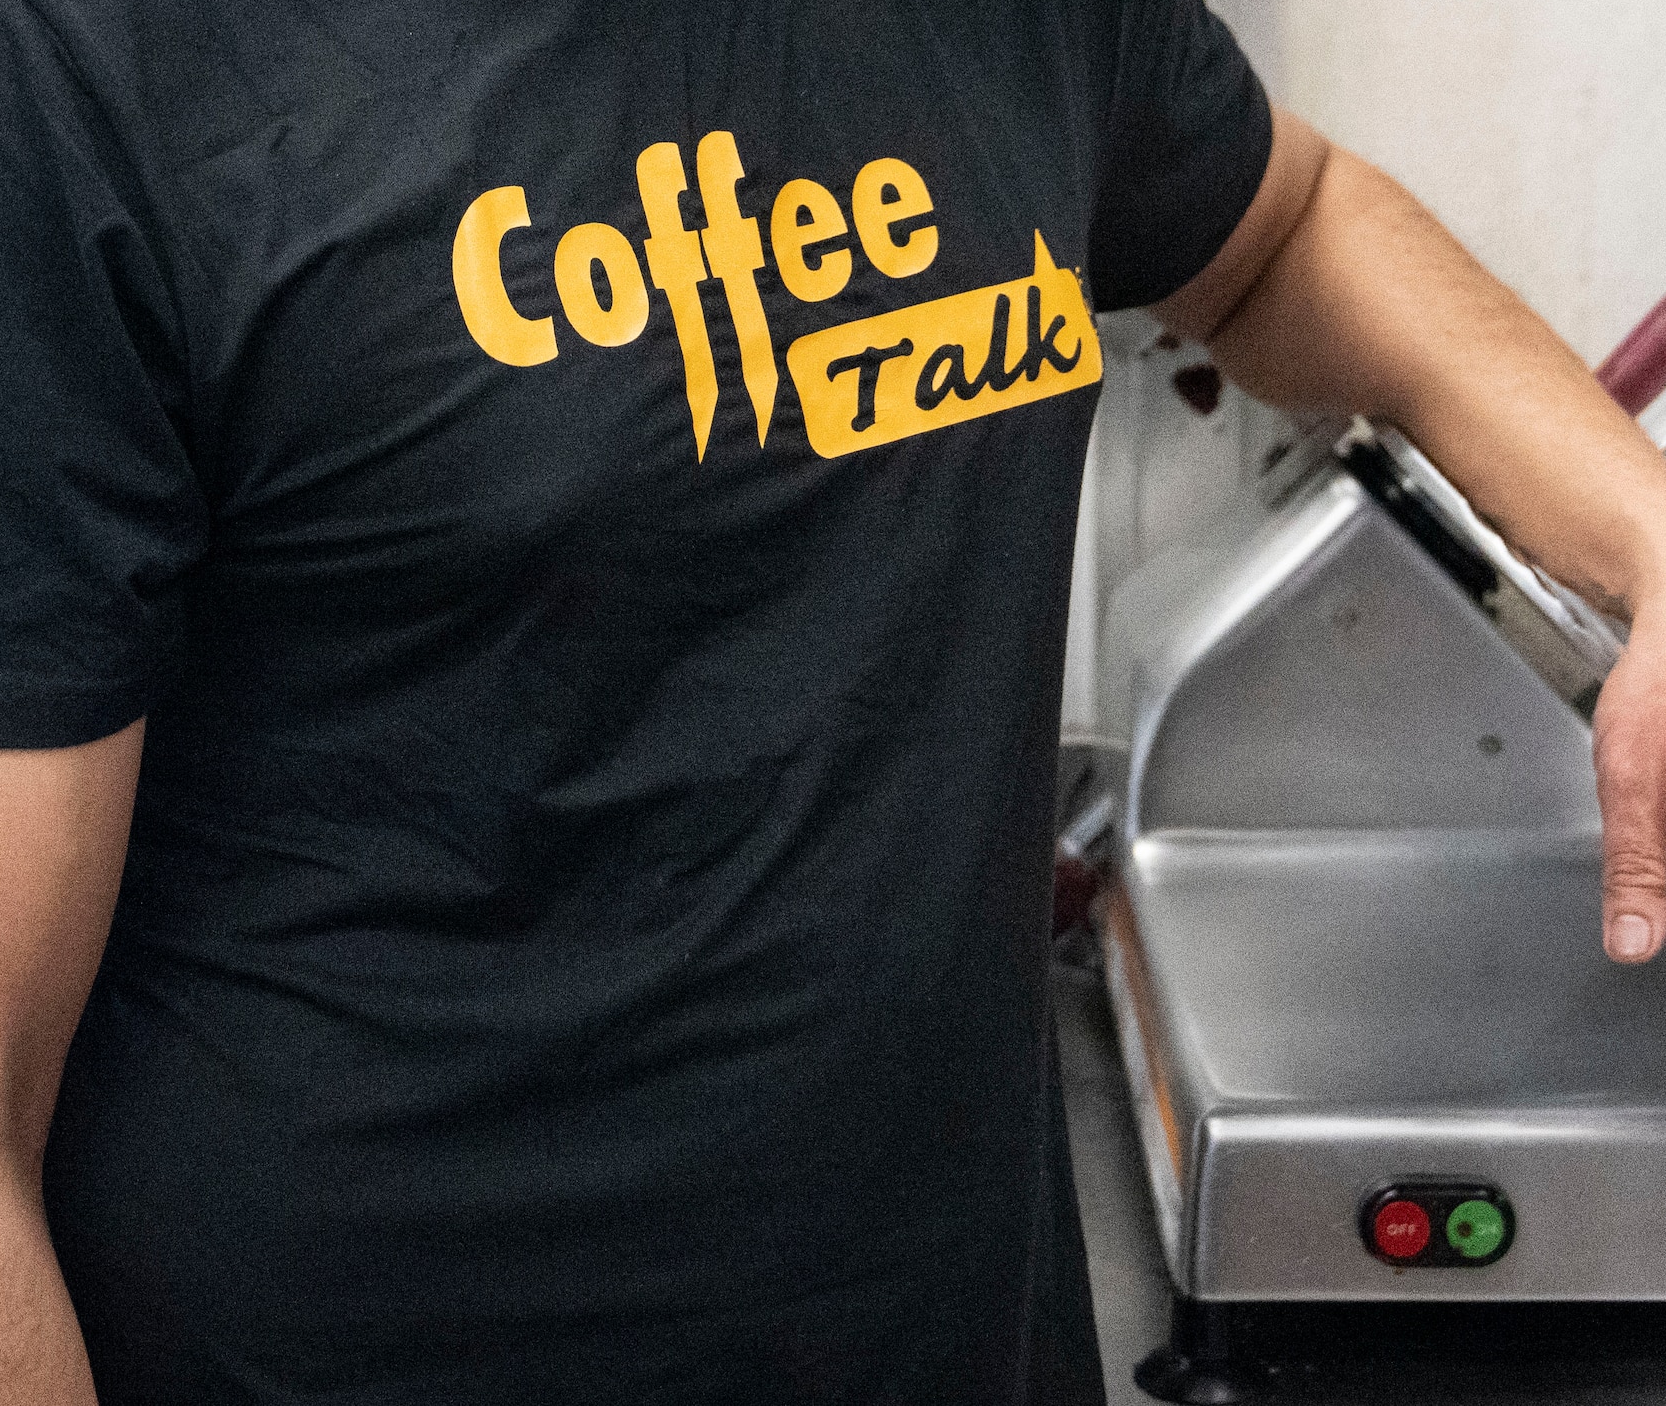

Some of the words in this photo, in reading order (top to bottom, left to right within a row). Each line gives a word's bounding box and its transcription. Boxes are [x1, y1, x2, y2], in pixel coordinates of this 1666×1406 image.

[452, 130, 939, 464] Coffee
[826, 284, 1082, 434] Talk
[1386, 1222, 1417, 1236] OFF
